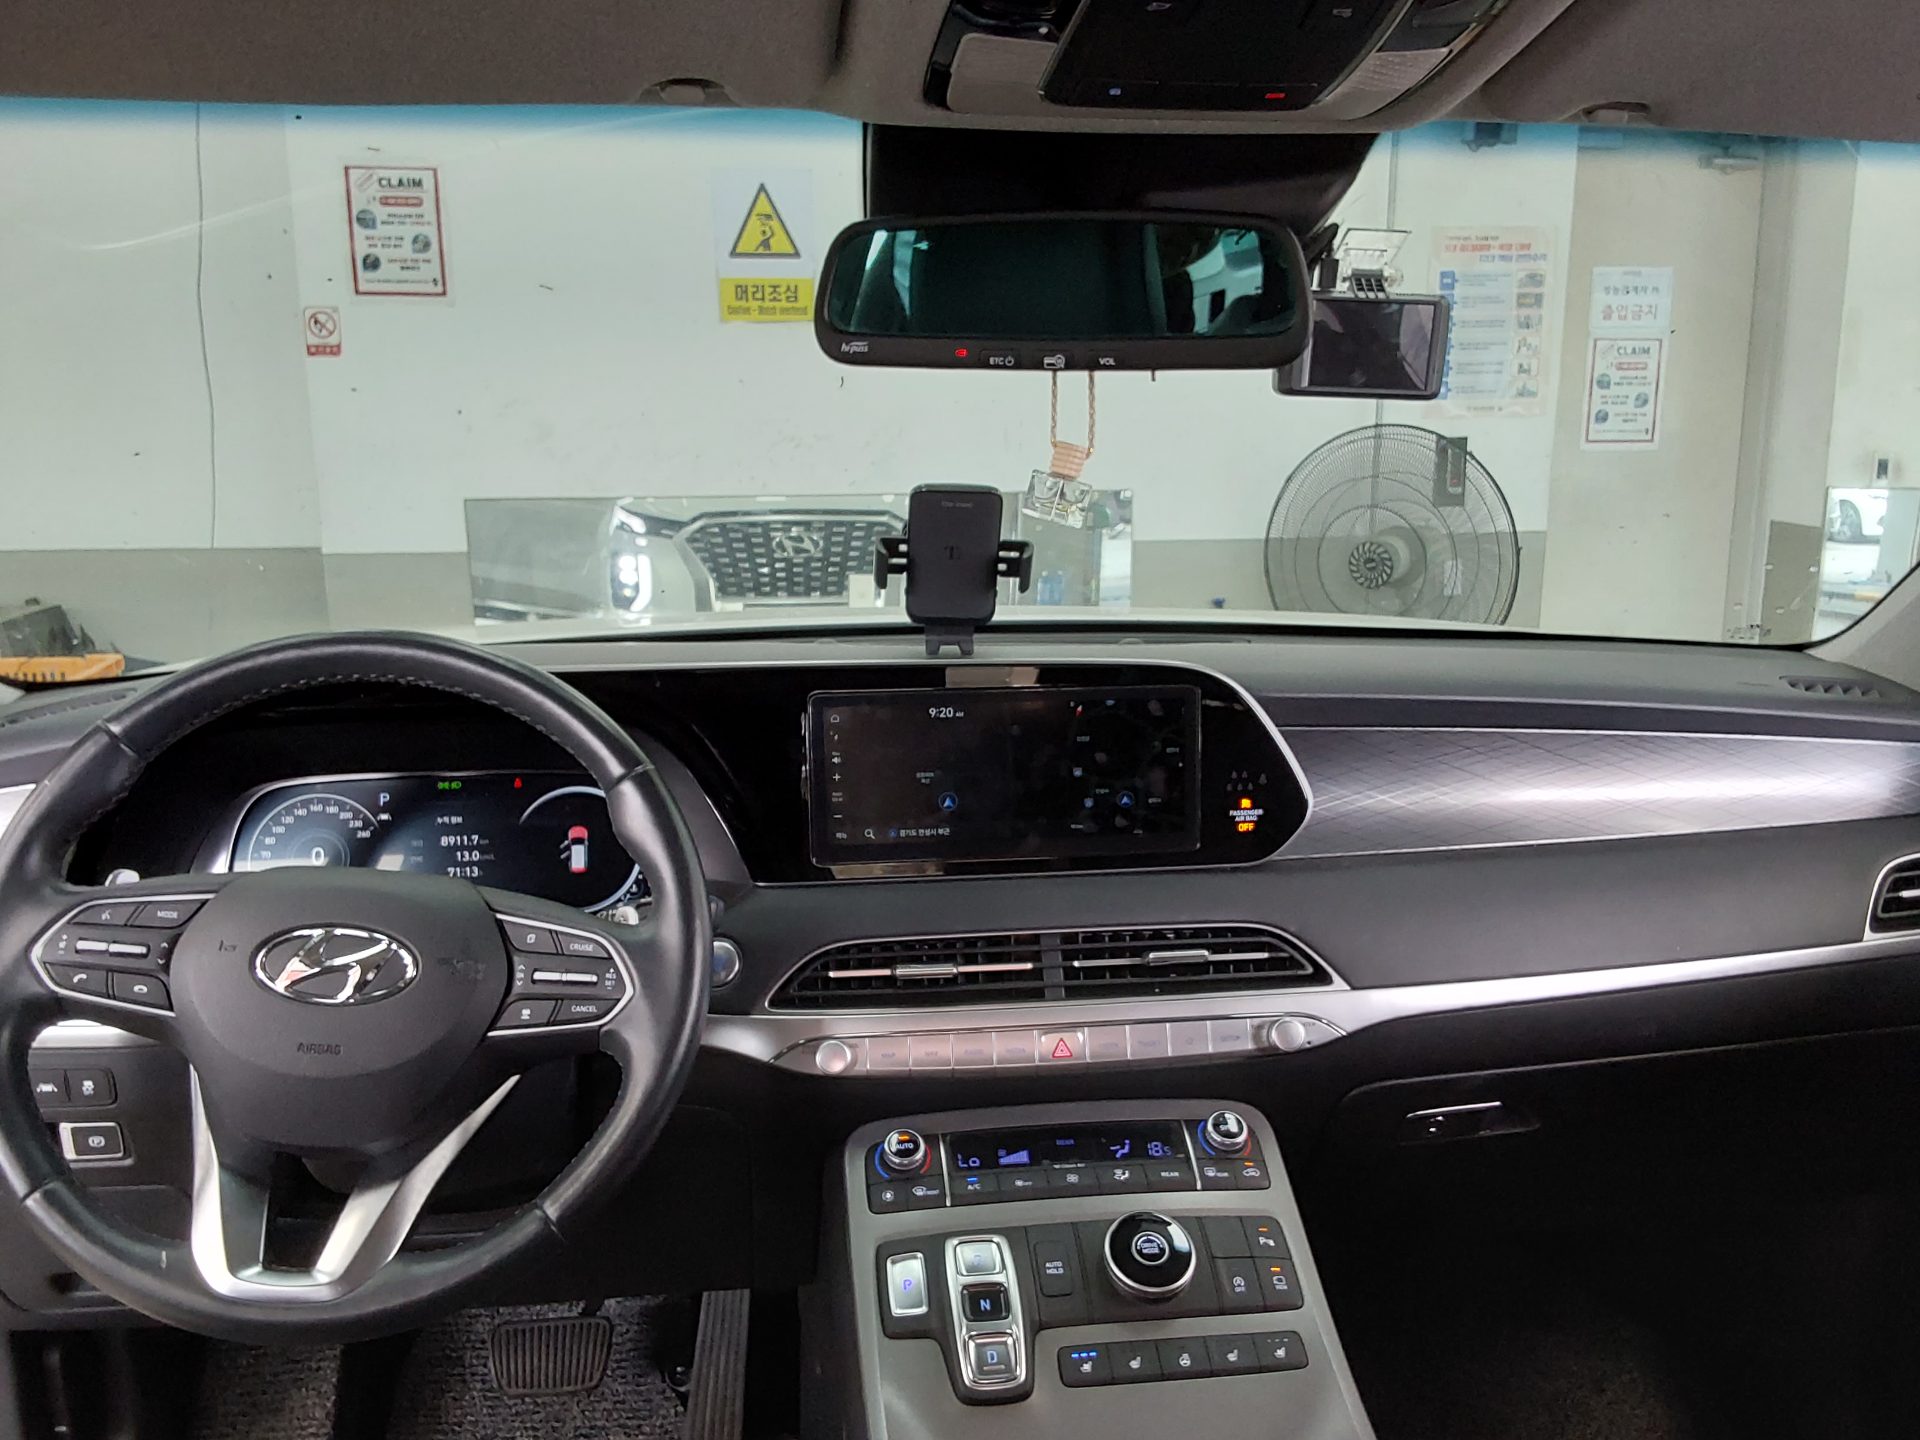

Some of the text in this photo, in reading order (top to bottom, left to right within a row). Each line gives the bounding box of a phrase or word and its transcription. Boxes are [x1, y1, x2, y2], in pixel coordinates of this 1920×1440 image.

[378, 177, 424, 189] CLAIM
[735, 284, 798, 303] 머리조심
[1601, 303, 1658, 321] 출입금지
[1616, 346, 1651, 356] CLAIM
[989, 356, 1004, 366] ETC
[1098, 357, 1116, 366] VOL
[929, 706, 954, 719] 9:20
[380, 793, 390, 806] P
[294, 808, 308, 817] 140
[309, 804, 324, 813] 160
[326, 806, 340, 814] 180
[1229, 808, 1264, 817] PASSENGER
[1238, 822, 1255, 832] OFF
[440, 834, 479, 847] 8911.7
[311, 846, 325, 866] 0
[456, 850, 480, 862] 13.0
[447, 865, 479, 878] 71:13
[157, 910, 178, 920] MODE
[569, 942, 594, 952] CRUISE
[571, 1004, 598, 1013] CANCEL
[296, 1042, 342, 1055] AIRBAG
[896, 1142, 915, 1150] AUTO
[967, 1183, 981, 1191] A/C
[1046, 1267, 1064, 1275] HOLD
[903, 1278, 913, 1291] P
[979, 1298, 992, 1311] N
[986, 1350, 998, 1364] D
